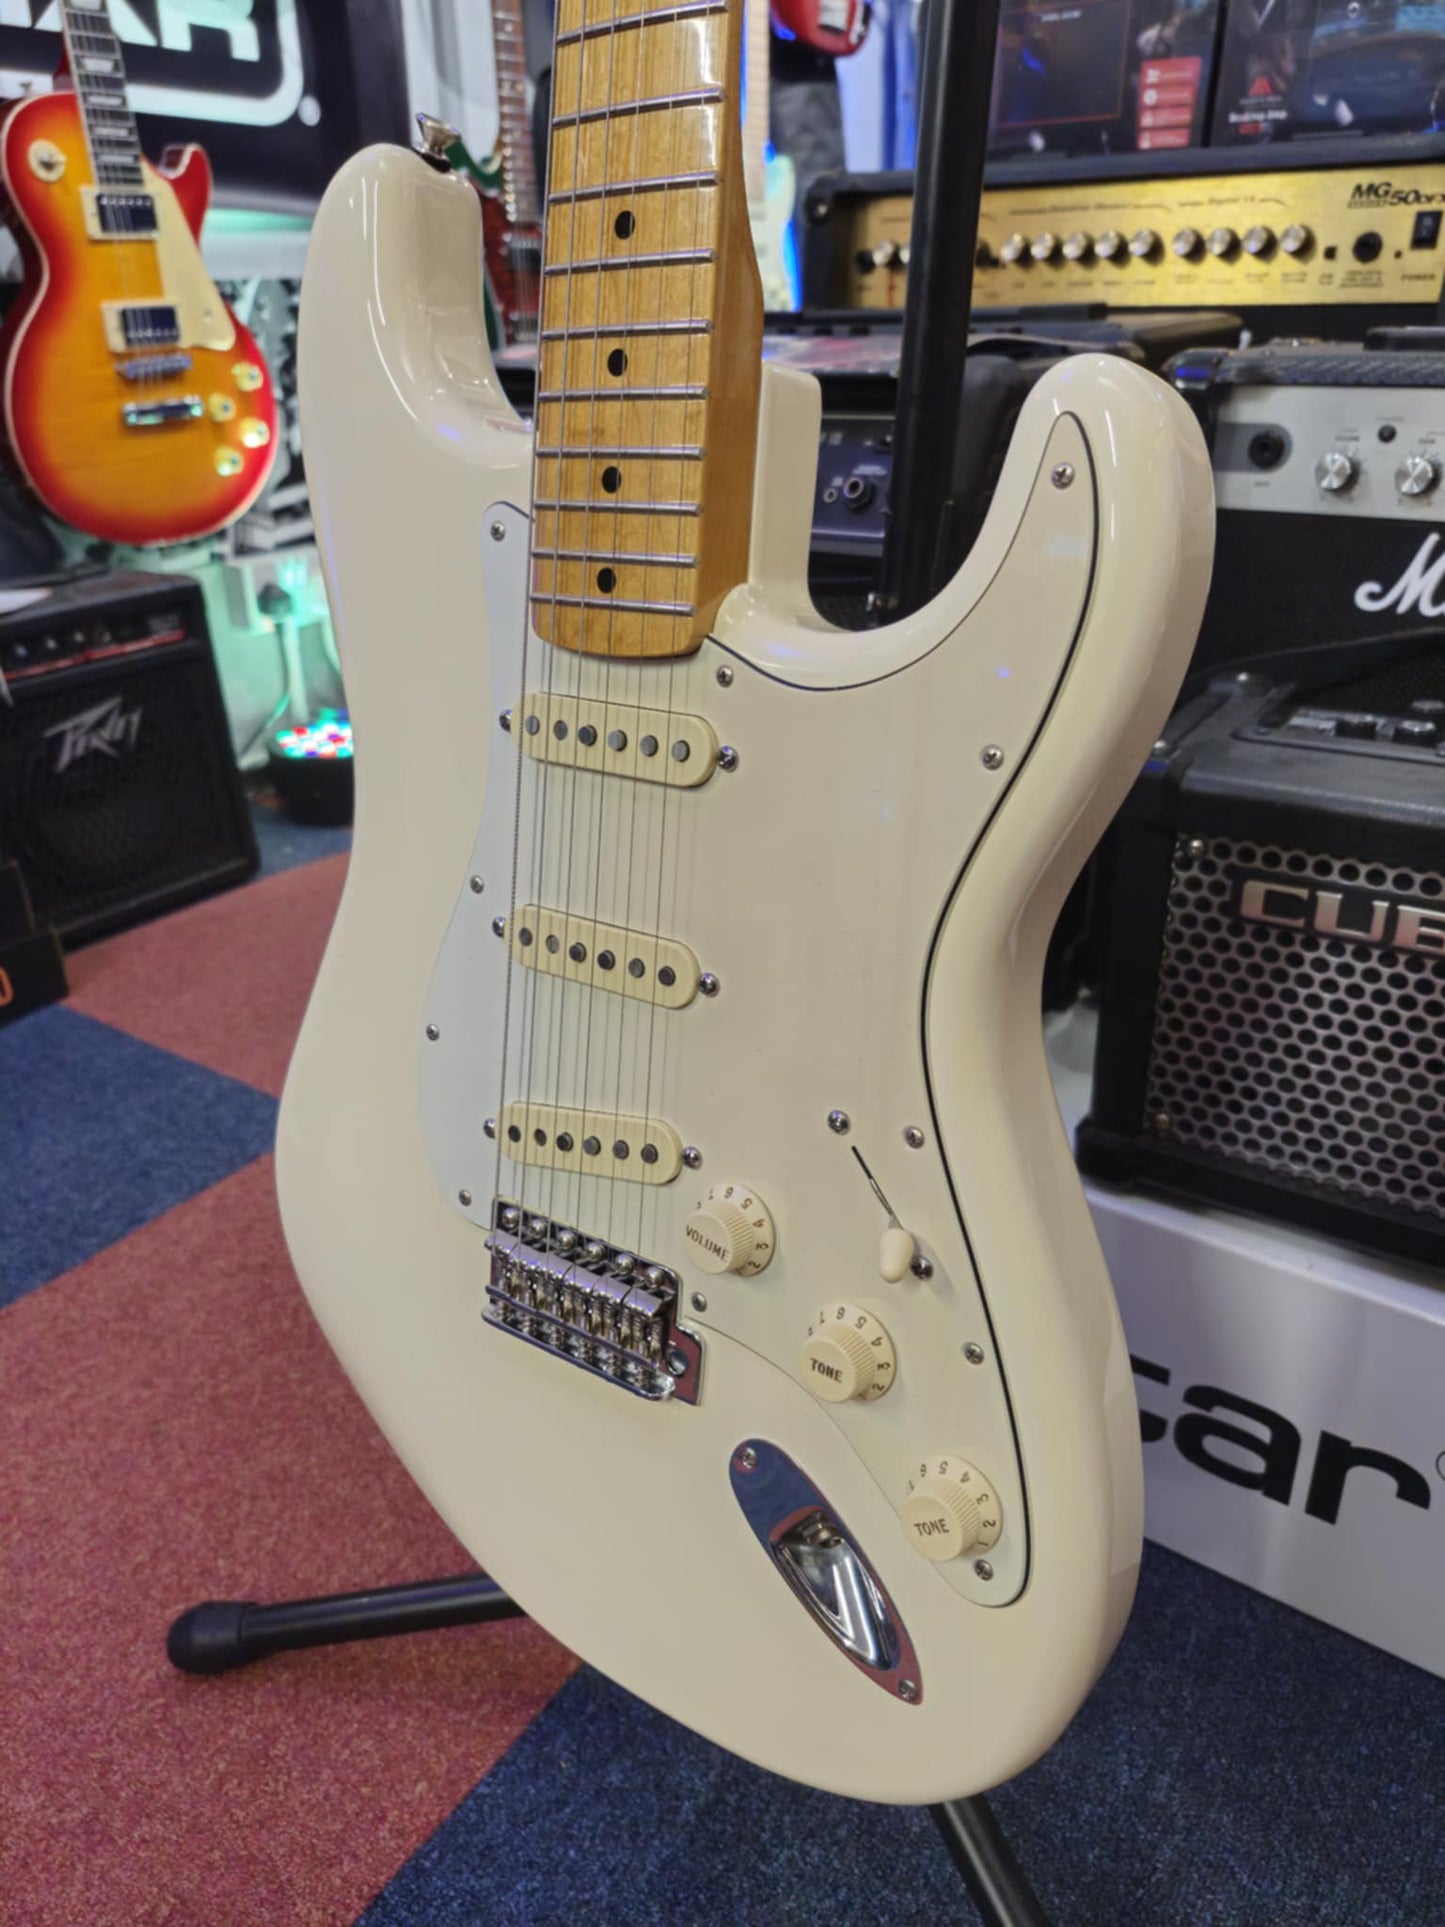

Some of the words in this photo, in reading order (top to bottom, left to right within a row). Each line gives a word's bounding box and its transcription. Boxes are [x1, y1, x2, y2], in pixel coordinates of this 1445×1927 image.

[685, 1224, 730, 1264] VOLUME
[810, 1357, 843, 1384] TONE
[914, 1518, 950, 1537] TONE
